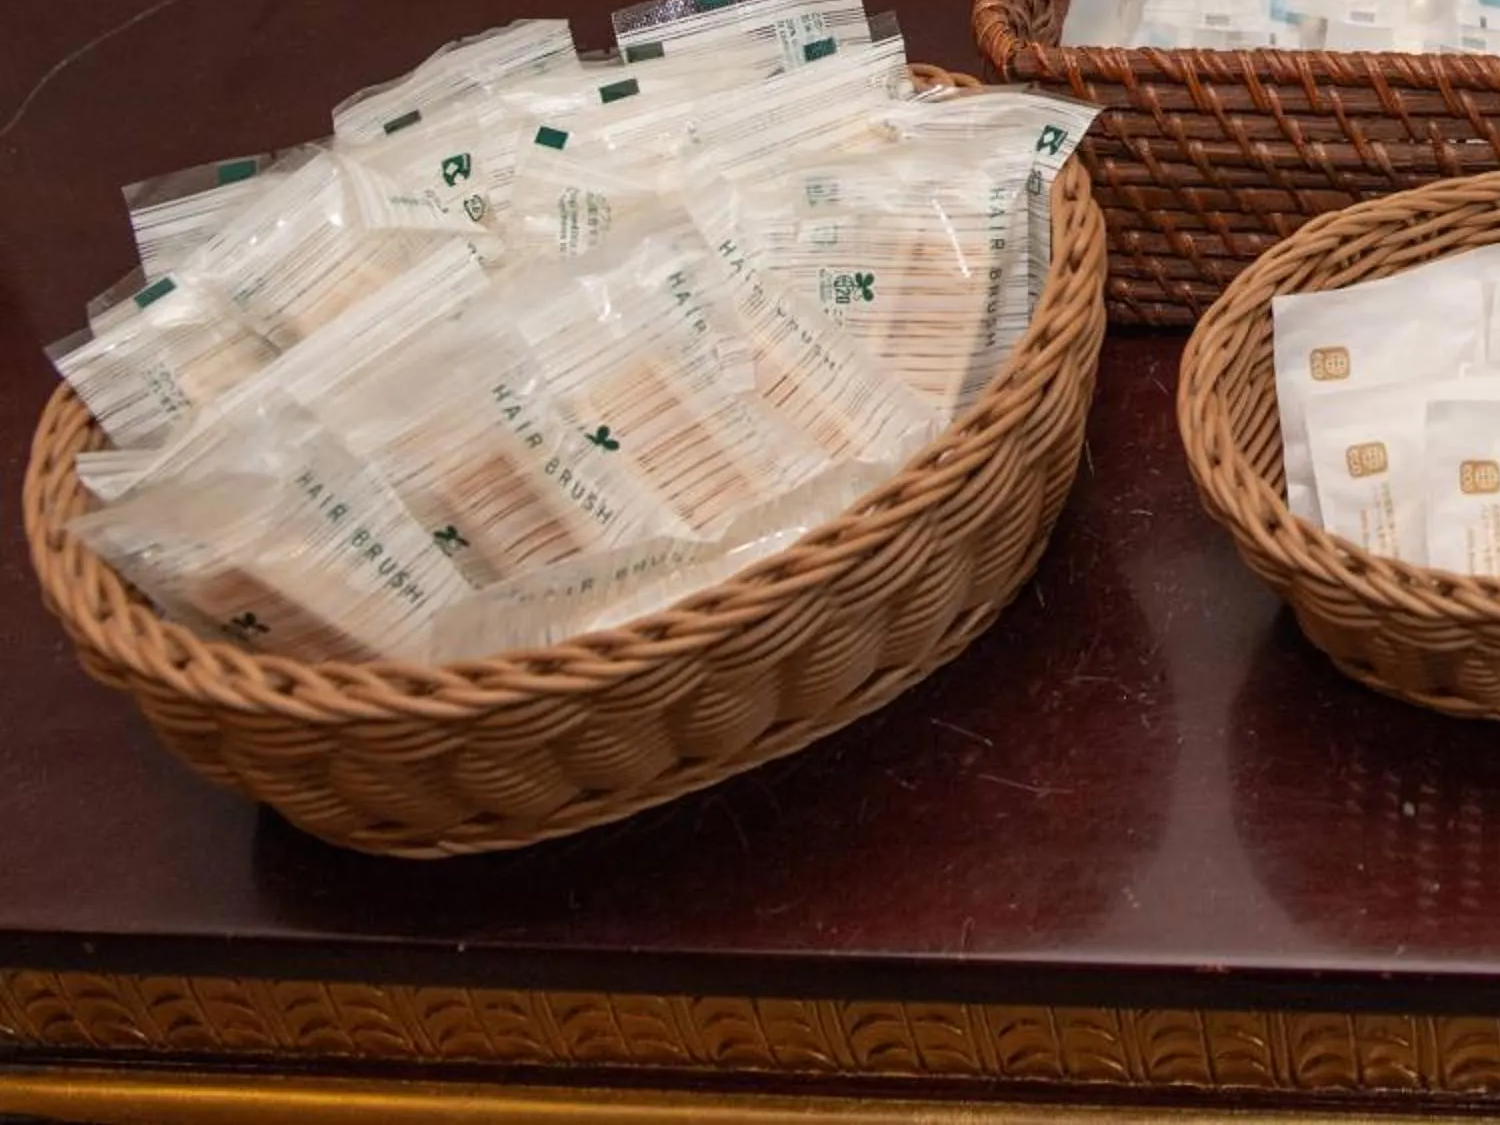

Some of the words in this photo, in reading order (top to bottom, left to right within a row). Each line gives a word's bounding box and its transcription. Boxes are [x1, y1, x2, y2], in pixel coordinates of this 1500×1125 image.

[492, 384, 544, 449] HAIR
[544, 457, 614, 525] BRUSH
[294, 469, 349, 524] HAIR
[351, 527, 424, 603] BRUSH
